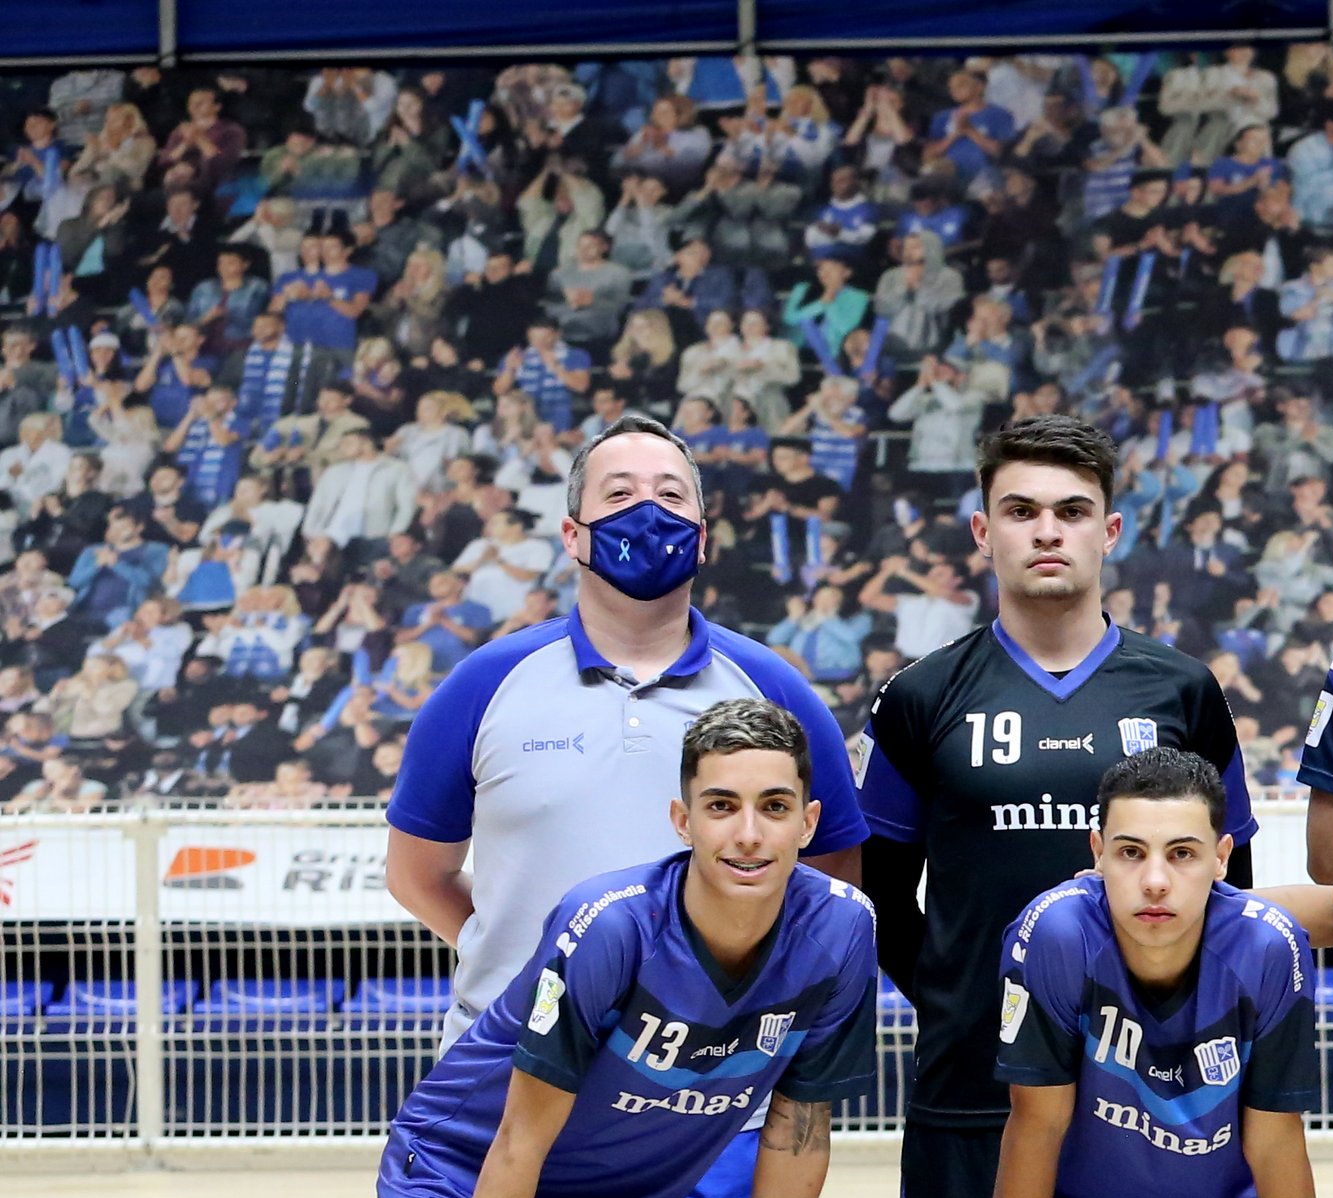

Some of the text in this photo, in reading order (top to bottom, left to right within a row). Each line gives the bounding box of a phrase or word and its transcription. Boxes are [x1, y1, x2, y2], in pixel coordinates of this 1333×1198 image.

[965, 711, 1022, 767] 19
[568, 902, 589, 929] Grupo
[573, 884, 647, 938] Risotolândia
[1262, 911, 1302, 992] Risotolândia
[626, 1012, 690, 1071] 13
[1094, 1005, 1143, 1071] 10
[611, 1086, 754, 1116] mnas
[1093, 1097, 1232, 1156] minas
